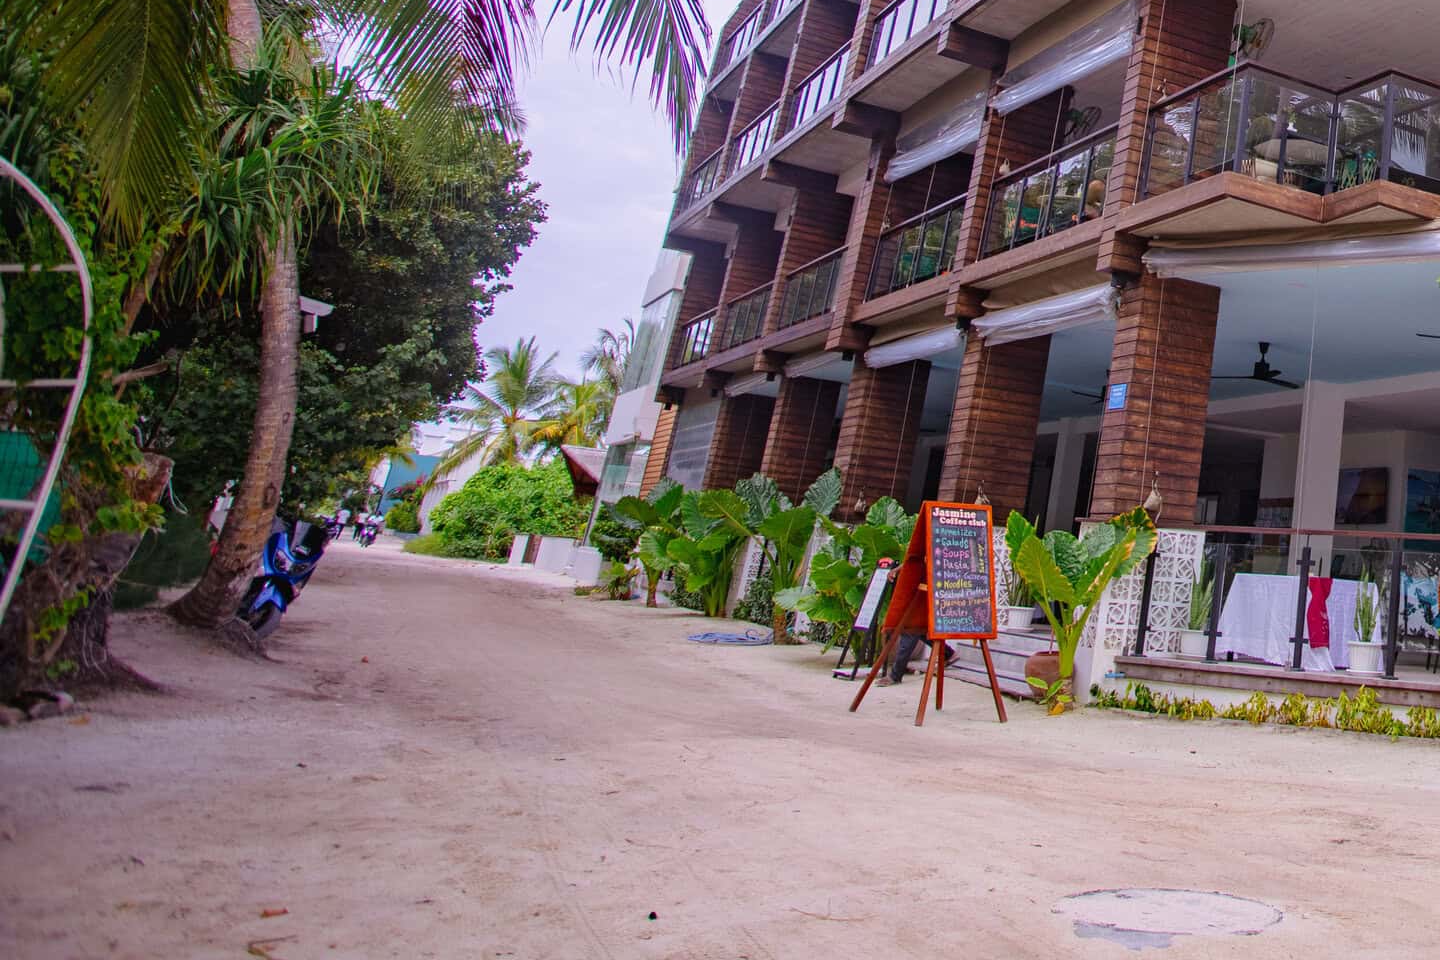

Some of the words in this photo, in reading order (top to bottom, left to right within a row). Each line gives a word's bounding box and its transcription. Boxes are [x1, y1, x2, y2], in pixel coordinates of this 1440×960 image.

[933, 507, 976, 518] Jasmine
[940, 517, 968, 525] Coffee
[968, 519, 987, 527] club
[942, 549, 970, 560] Soups
[943, 579, 973, 590] Noodles
